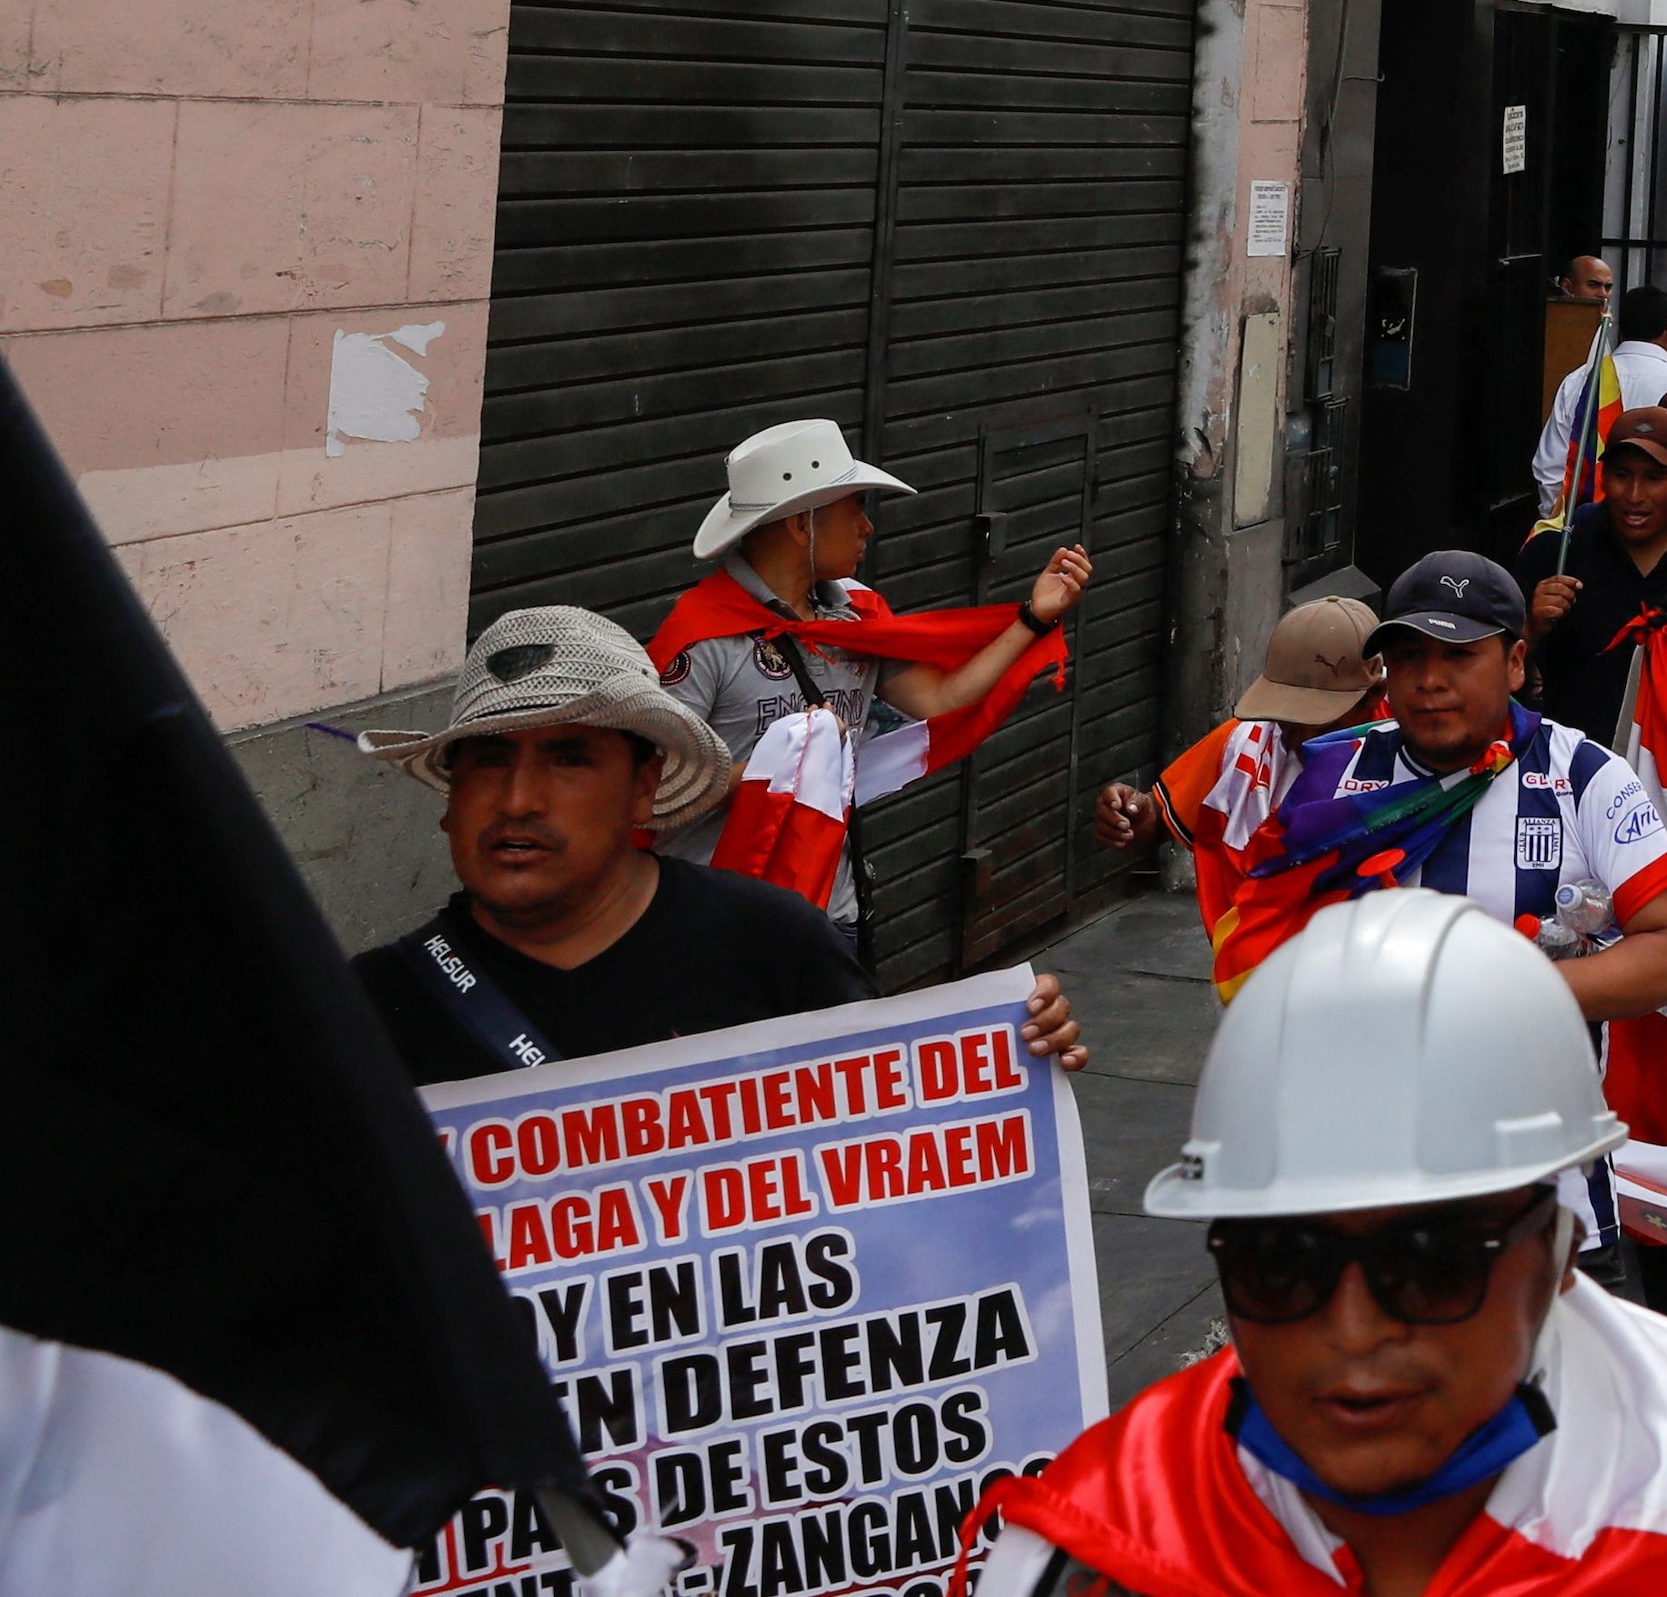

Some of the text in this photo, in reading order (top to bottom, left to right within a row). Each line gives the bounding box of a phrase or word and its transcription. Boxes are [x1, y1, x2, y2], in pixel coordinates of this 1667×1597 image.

[471, 1031, 1022, 1184] COMBATIENTE DEL
[648, 1177, 685, 1239] Y
[704, 1156, 811, 1231] DEL
[820, 1116, 1028, 1207] VRAEM
[608, 1262, 700, 1351] EN
[719, 1233, 854, 1327] LAS
[662, 1290, 1030, 1433] DEFENZA
[461, 1466, 638, 1572] PAS
[656, 1440, 749, 1528] DE
[764, 1391, 986, 1502] ESTOS
